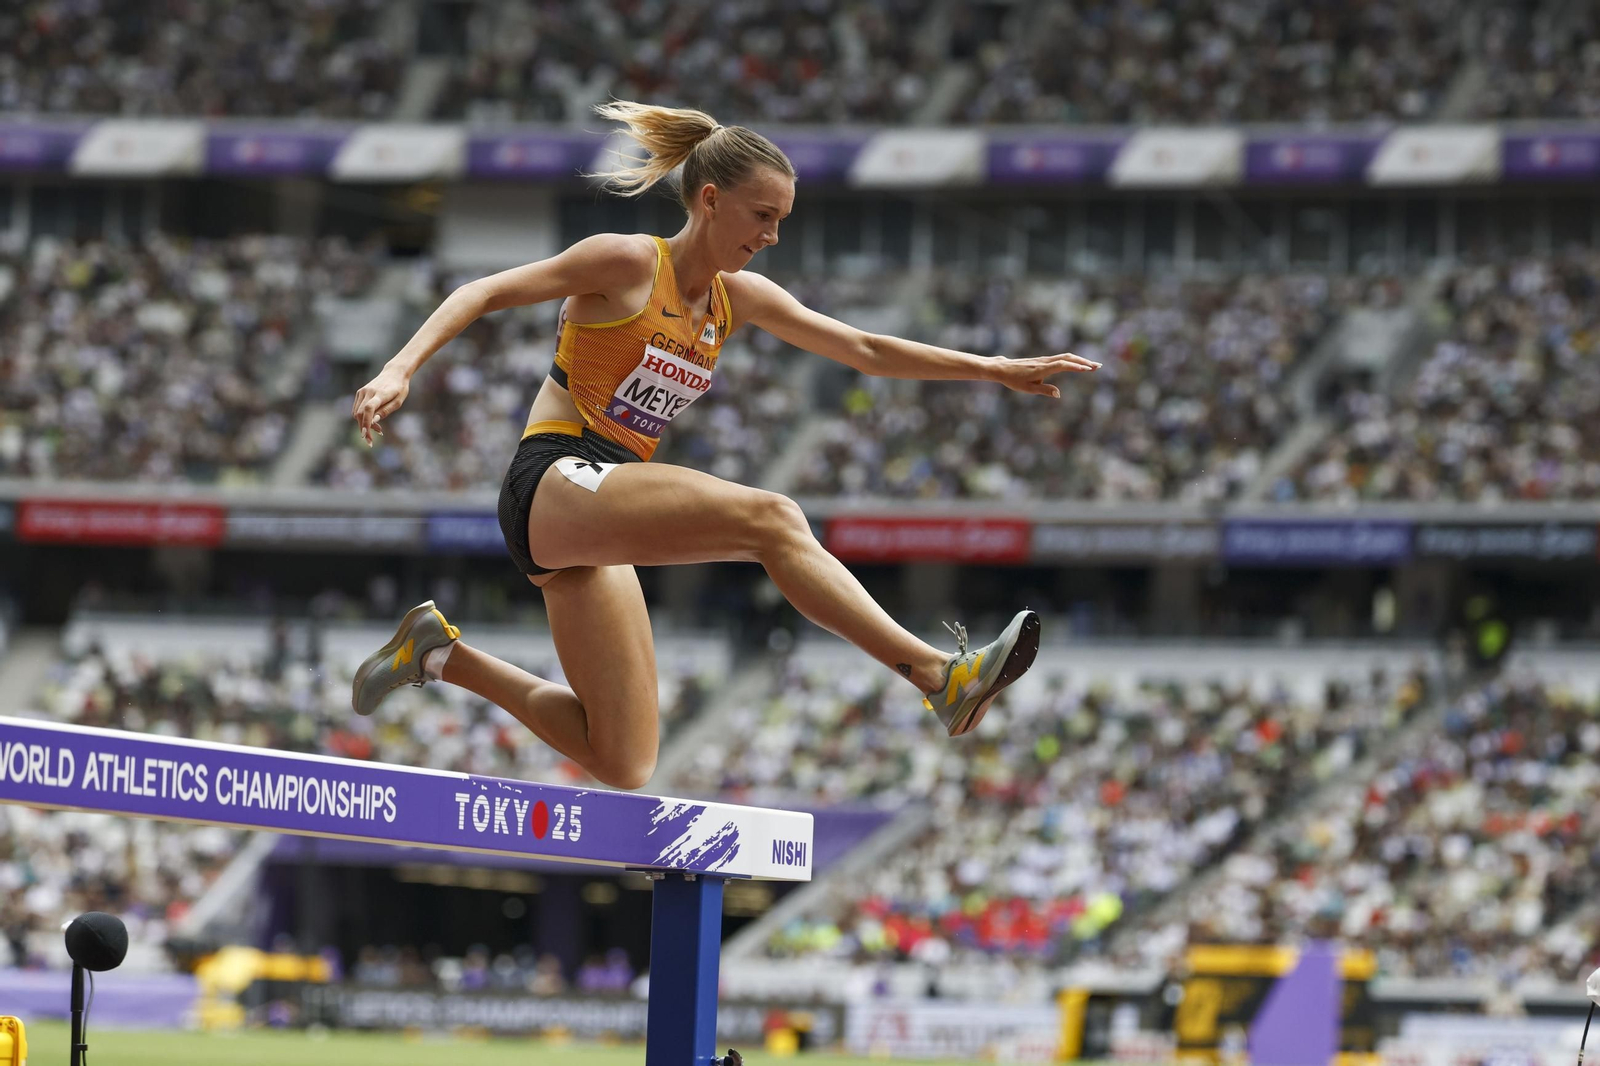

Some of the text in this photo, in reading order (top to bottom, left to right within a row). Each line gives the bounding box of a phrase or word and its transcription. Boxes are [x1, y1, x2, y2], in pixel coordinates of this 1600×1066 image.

[651, 332, 717, 371] GERMAN
[642, 353, 711, 392] HONDA
[81, 751, 208, 803] ATHLETICS
[215, 766, 397, 823] CHAMPIONSHIPS
[772, 839, 806, 867] NISHI
